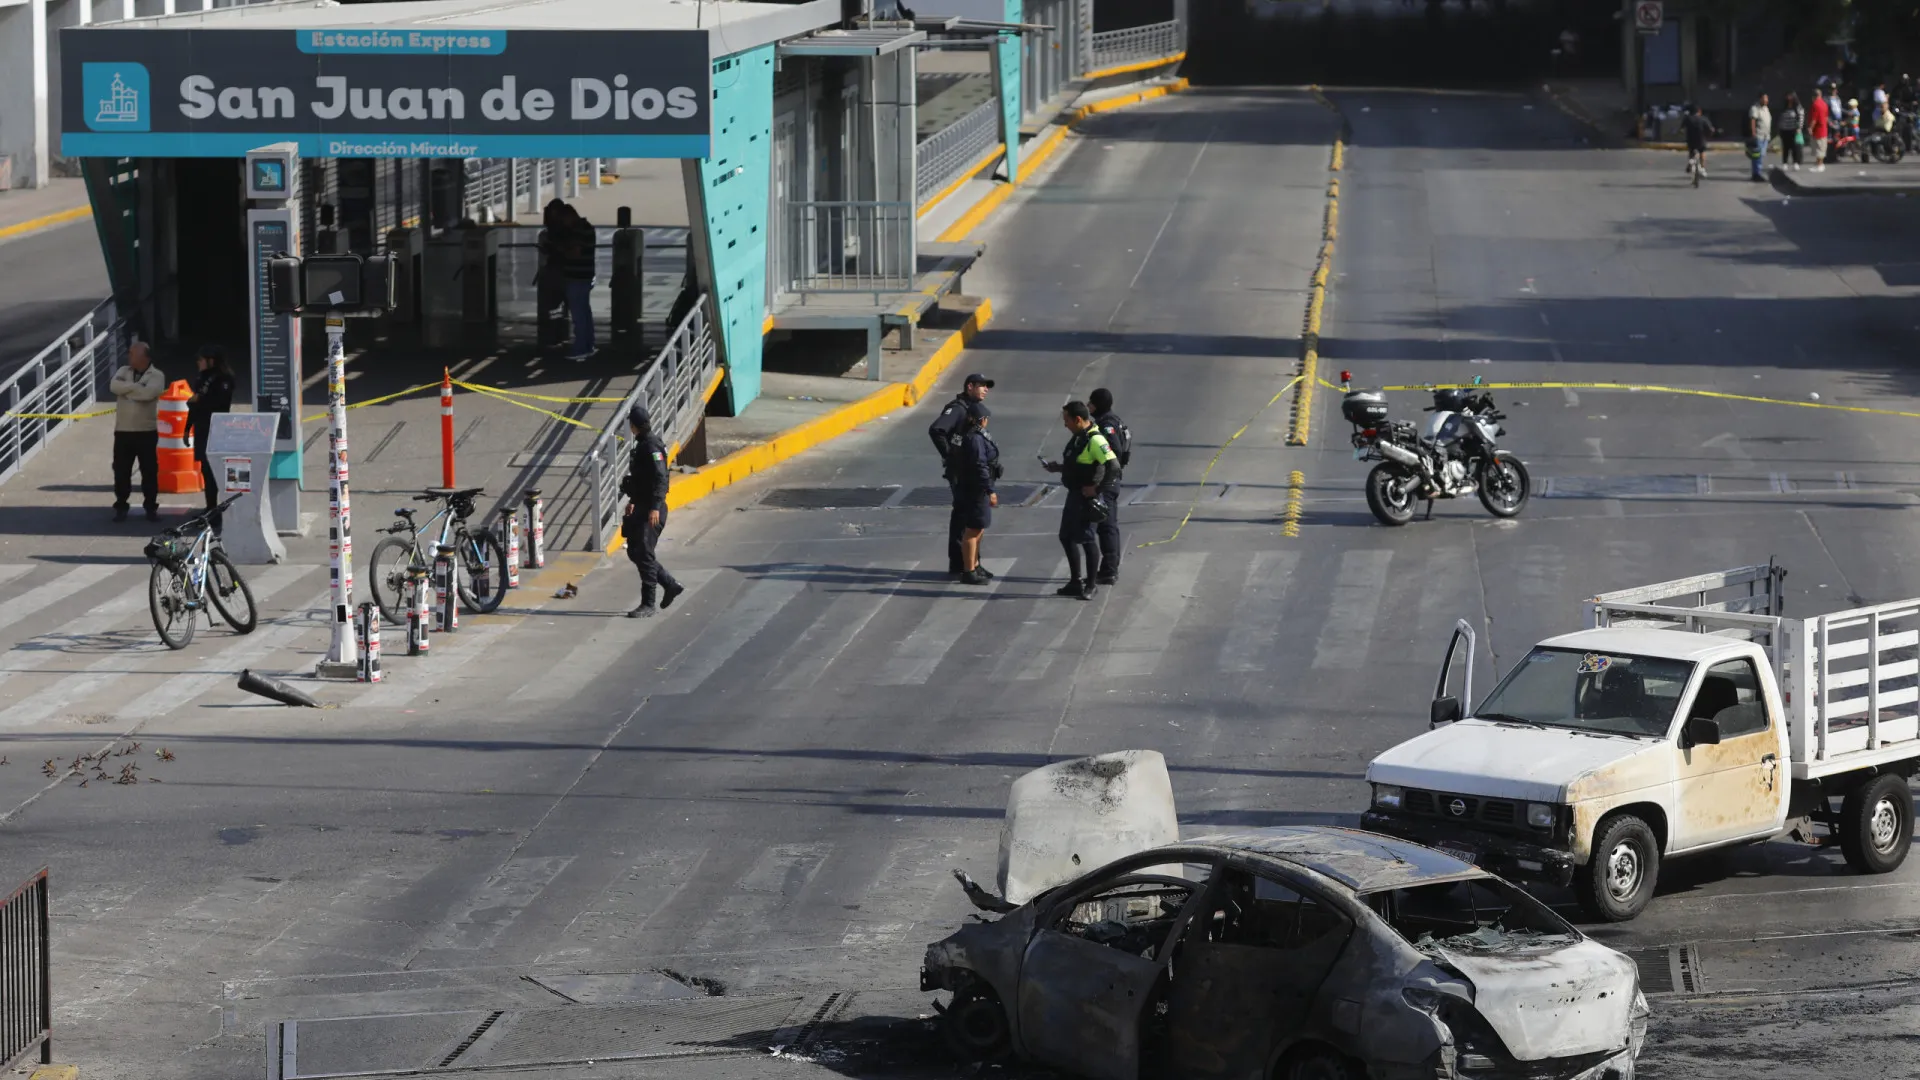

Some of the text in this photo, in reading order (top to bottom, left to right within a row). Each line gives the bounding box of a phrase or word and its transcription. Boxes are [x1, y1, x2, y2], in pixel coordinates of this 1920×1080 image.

[310, 30, 491, 53] Estación Express
[179, 73, 698, 121] San Juan de Dios
[328, 140, 478, 156] Dirección Mirador
